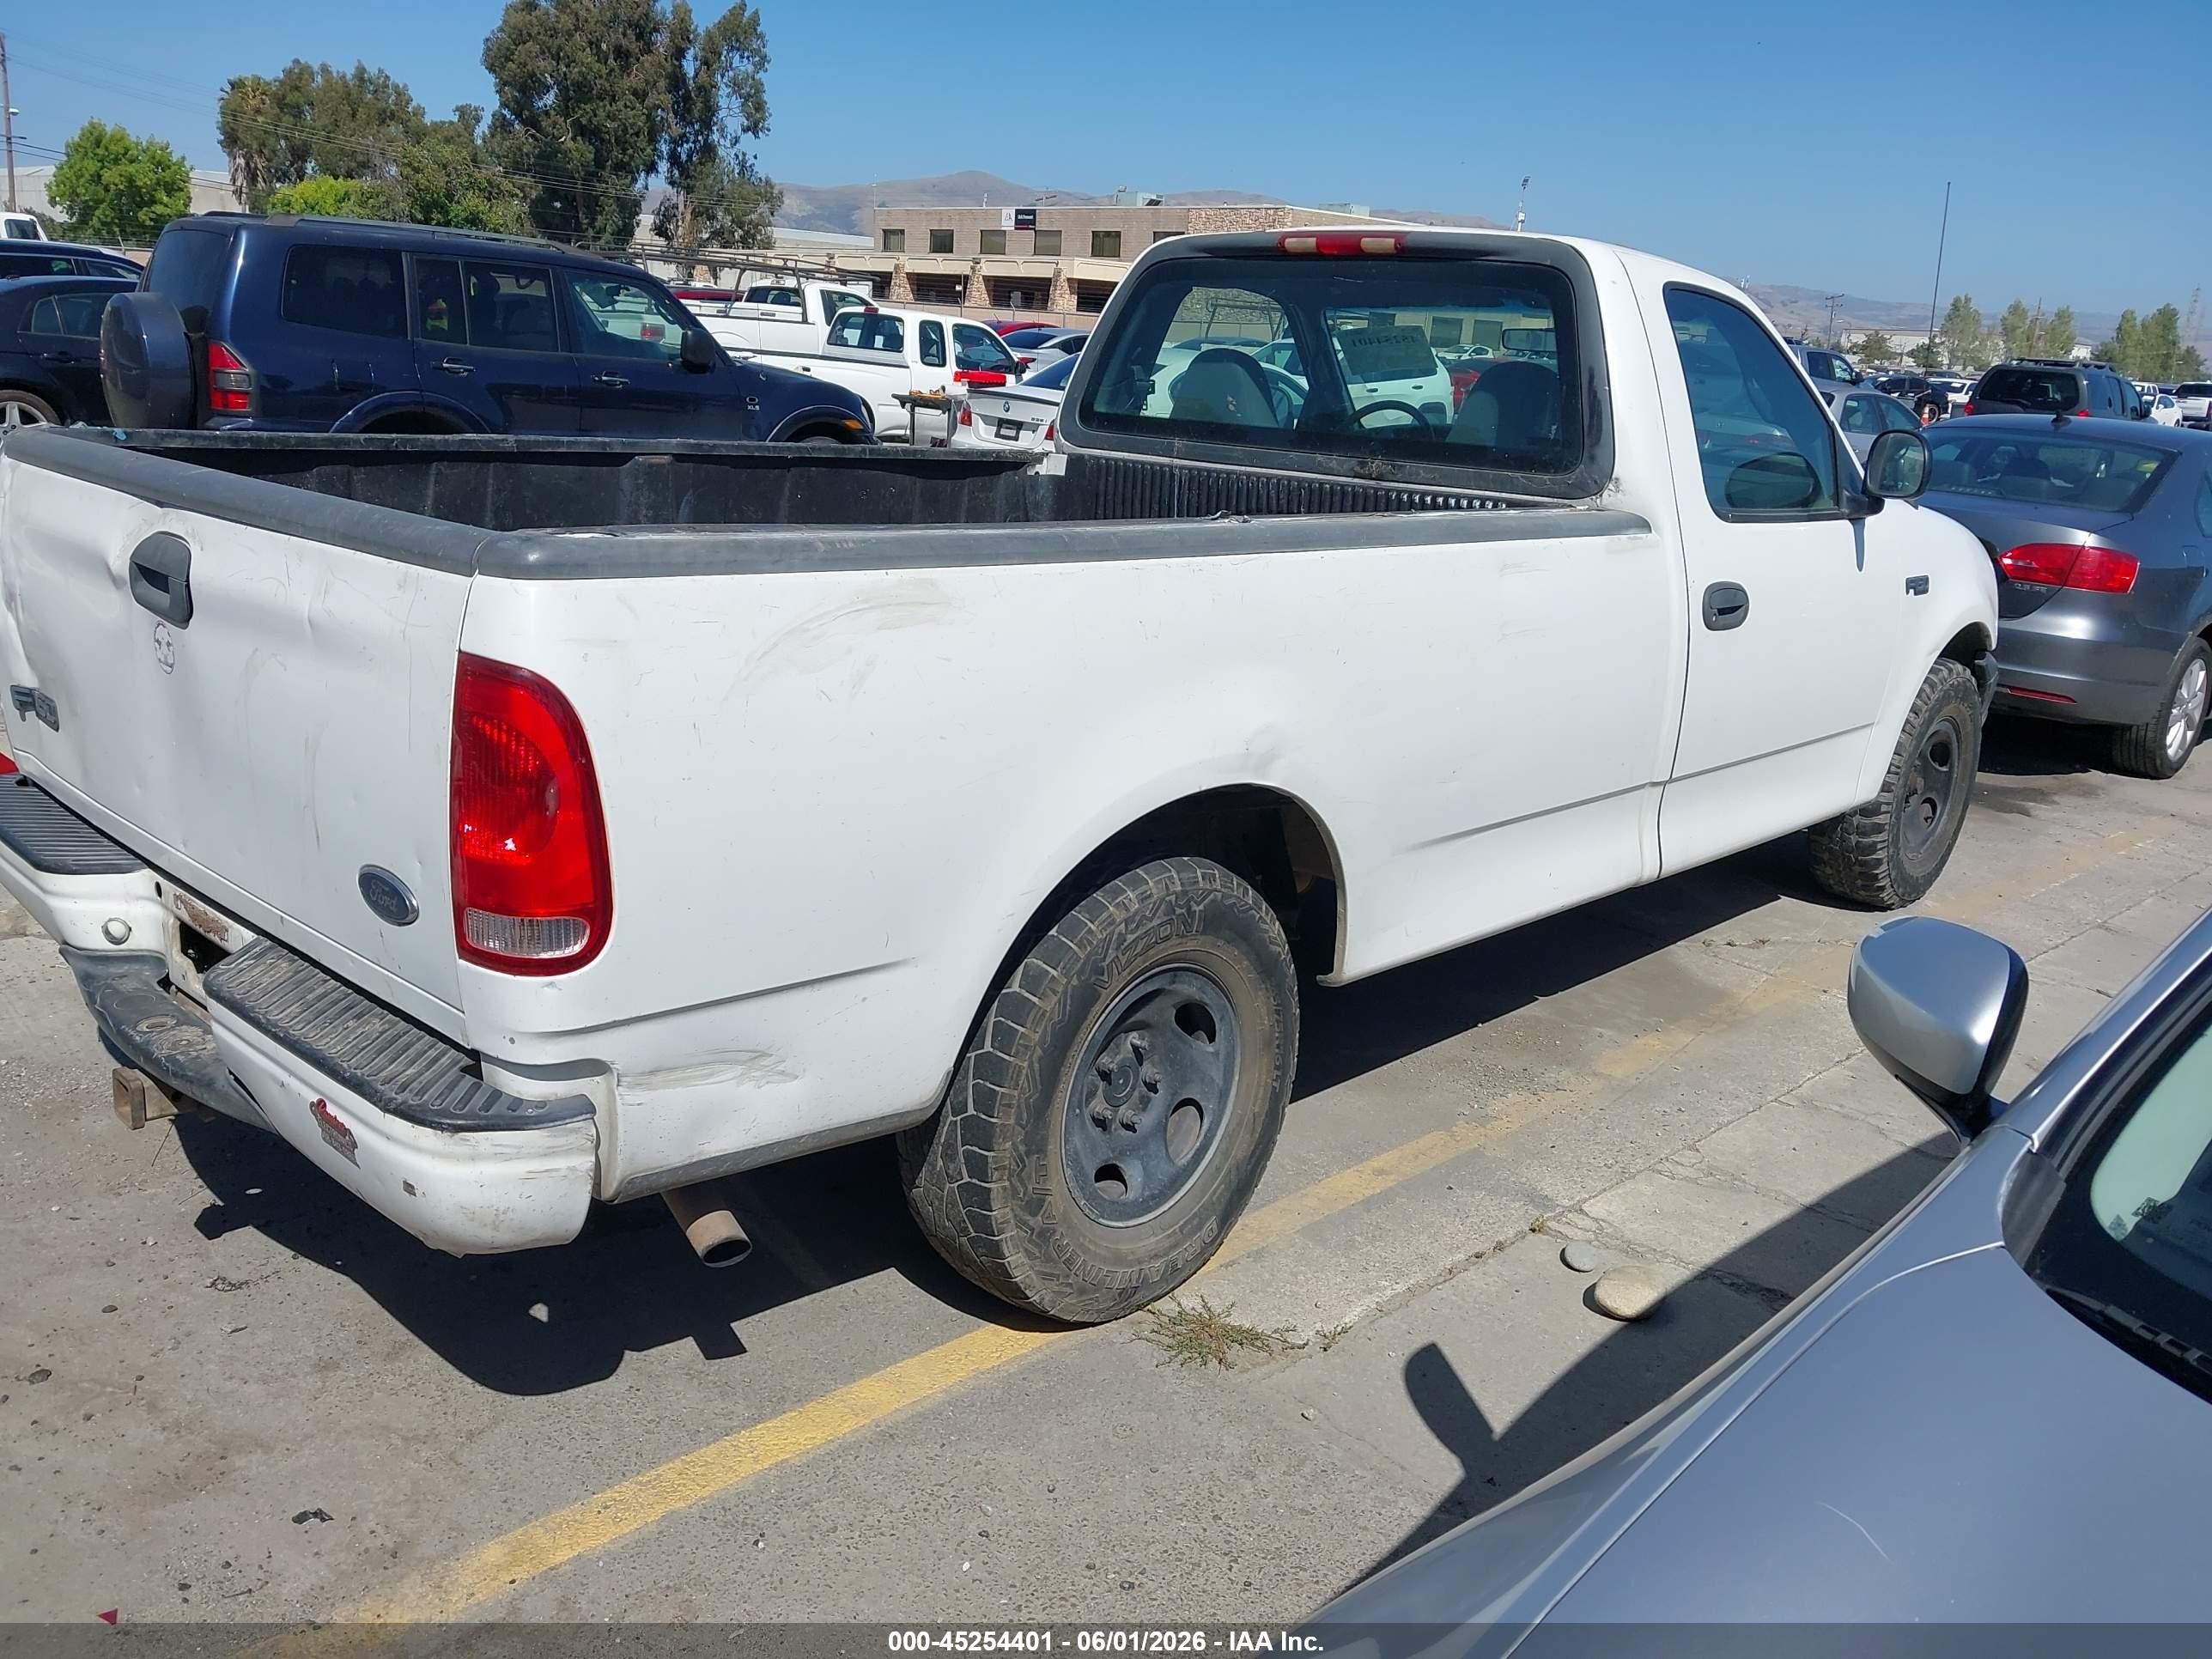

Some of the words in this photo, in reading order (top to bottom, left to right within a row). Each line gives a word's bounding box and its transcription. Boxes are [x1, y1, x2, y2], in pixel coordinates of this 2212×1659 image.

[369, 878, 398, 912] Ford
[1092, 908, 1206, 989] VIZZONI
[1031, 1155, 1058, 1224] A/T
[1049, 1215, 1218, 1290] DREAMLINER
